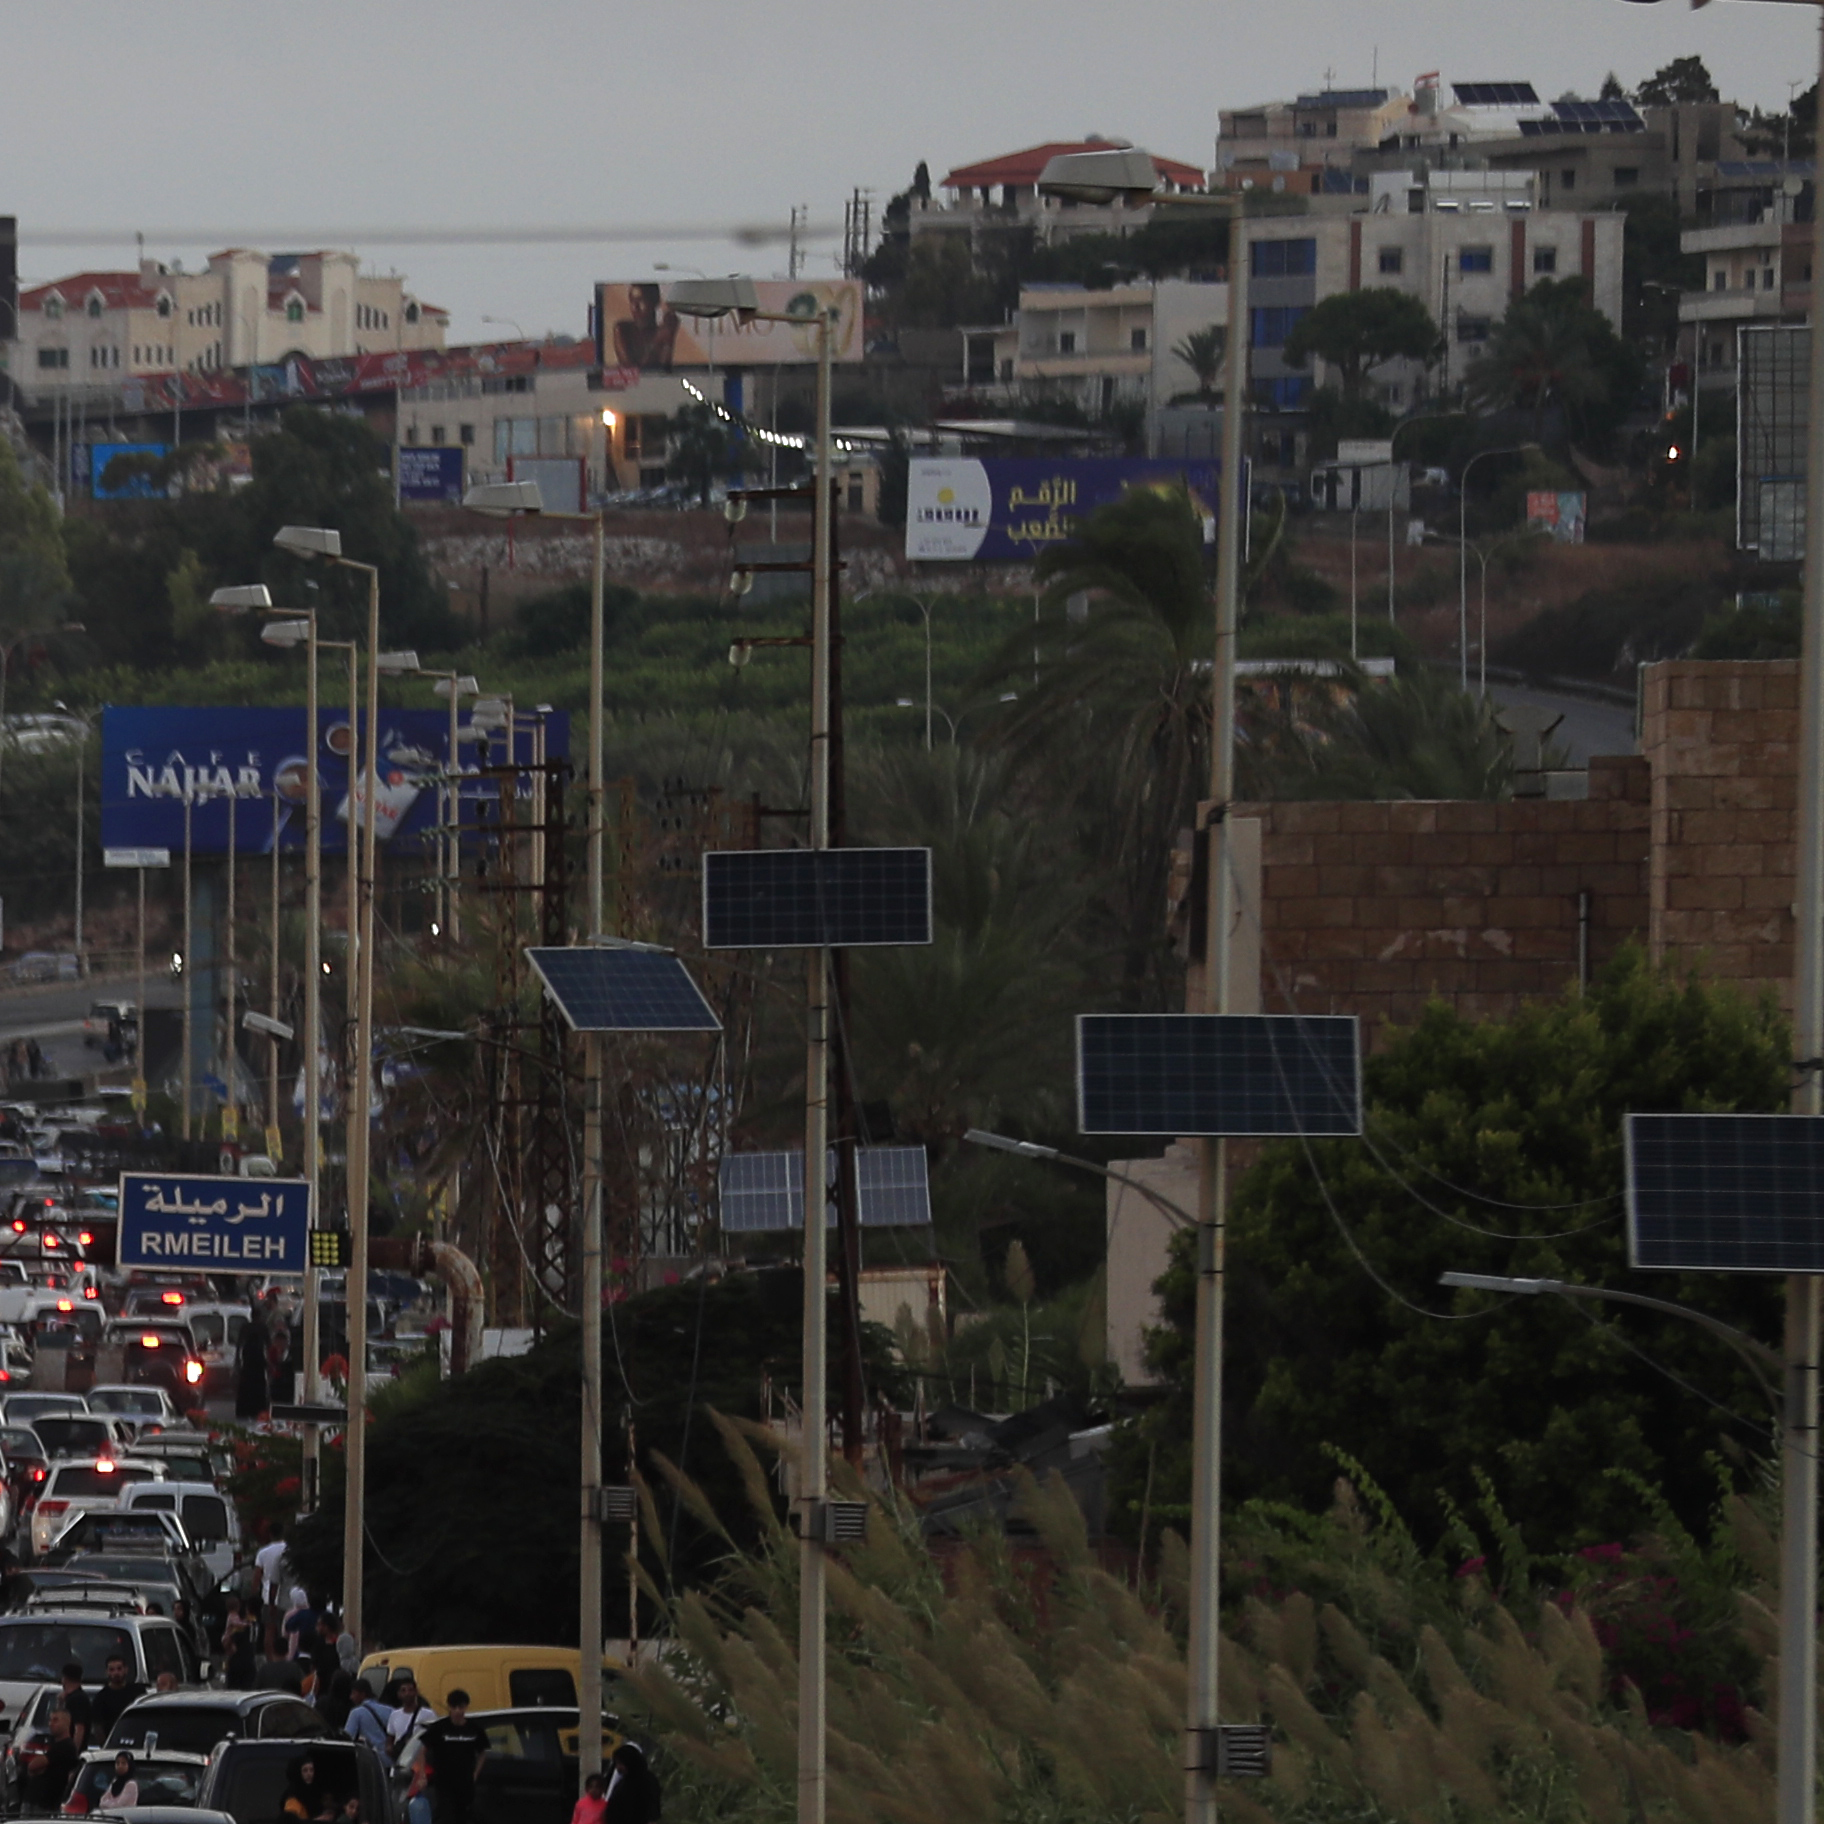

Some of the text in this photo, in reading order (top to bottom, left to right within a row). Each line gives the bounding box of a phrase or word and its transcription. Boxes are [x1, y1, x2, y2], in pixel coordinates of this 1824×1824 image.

[125, 748, 263, 766] CAFE
[126, 765, 263, 806] NAJJAR
[142, 1182, 284, 1224] الرميلة
[141, 1231, 286, 1260] RMEILEH
